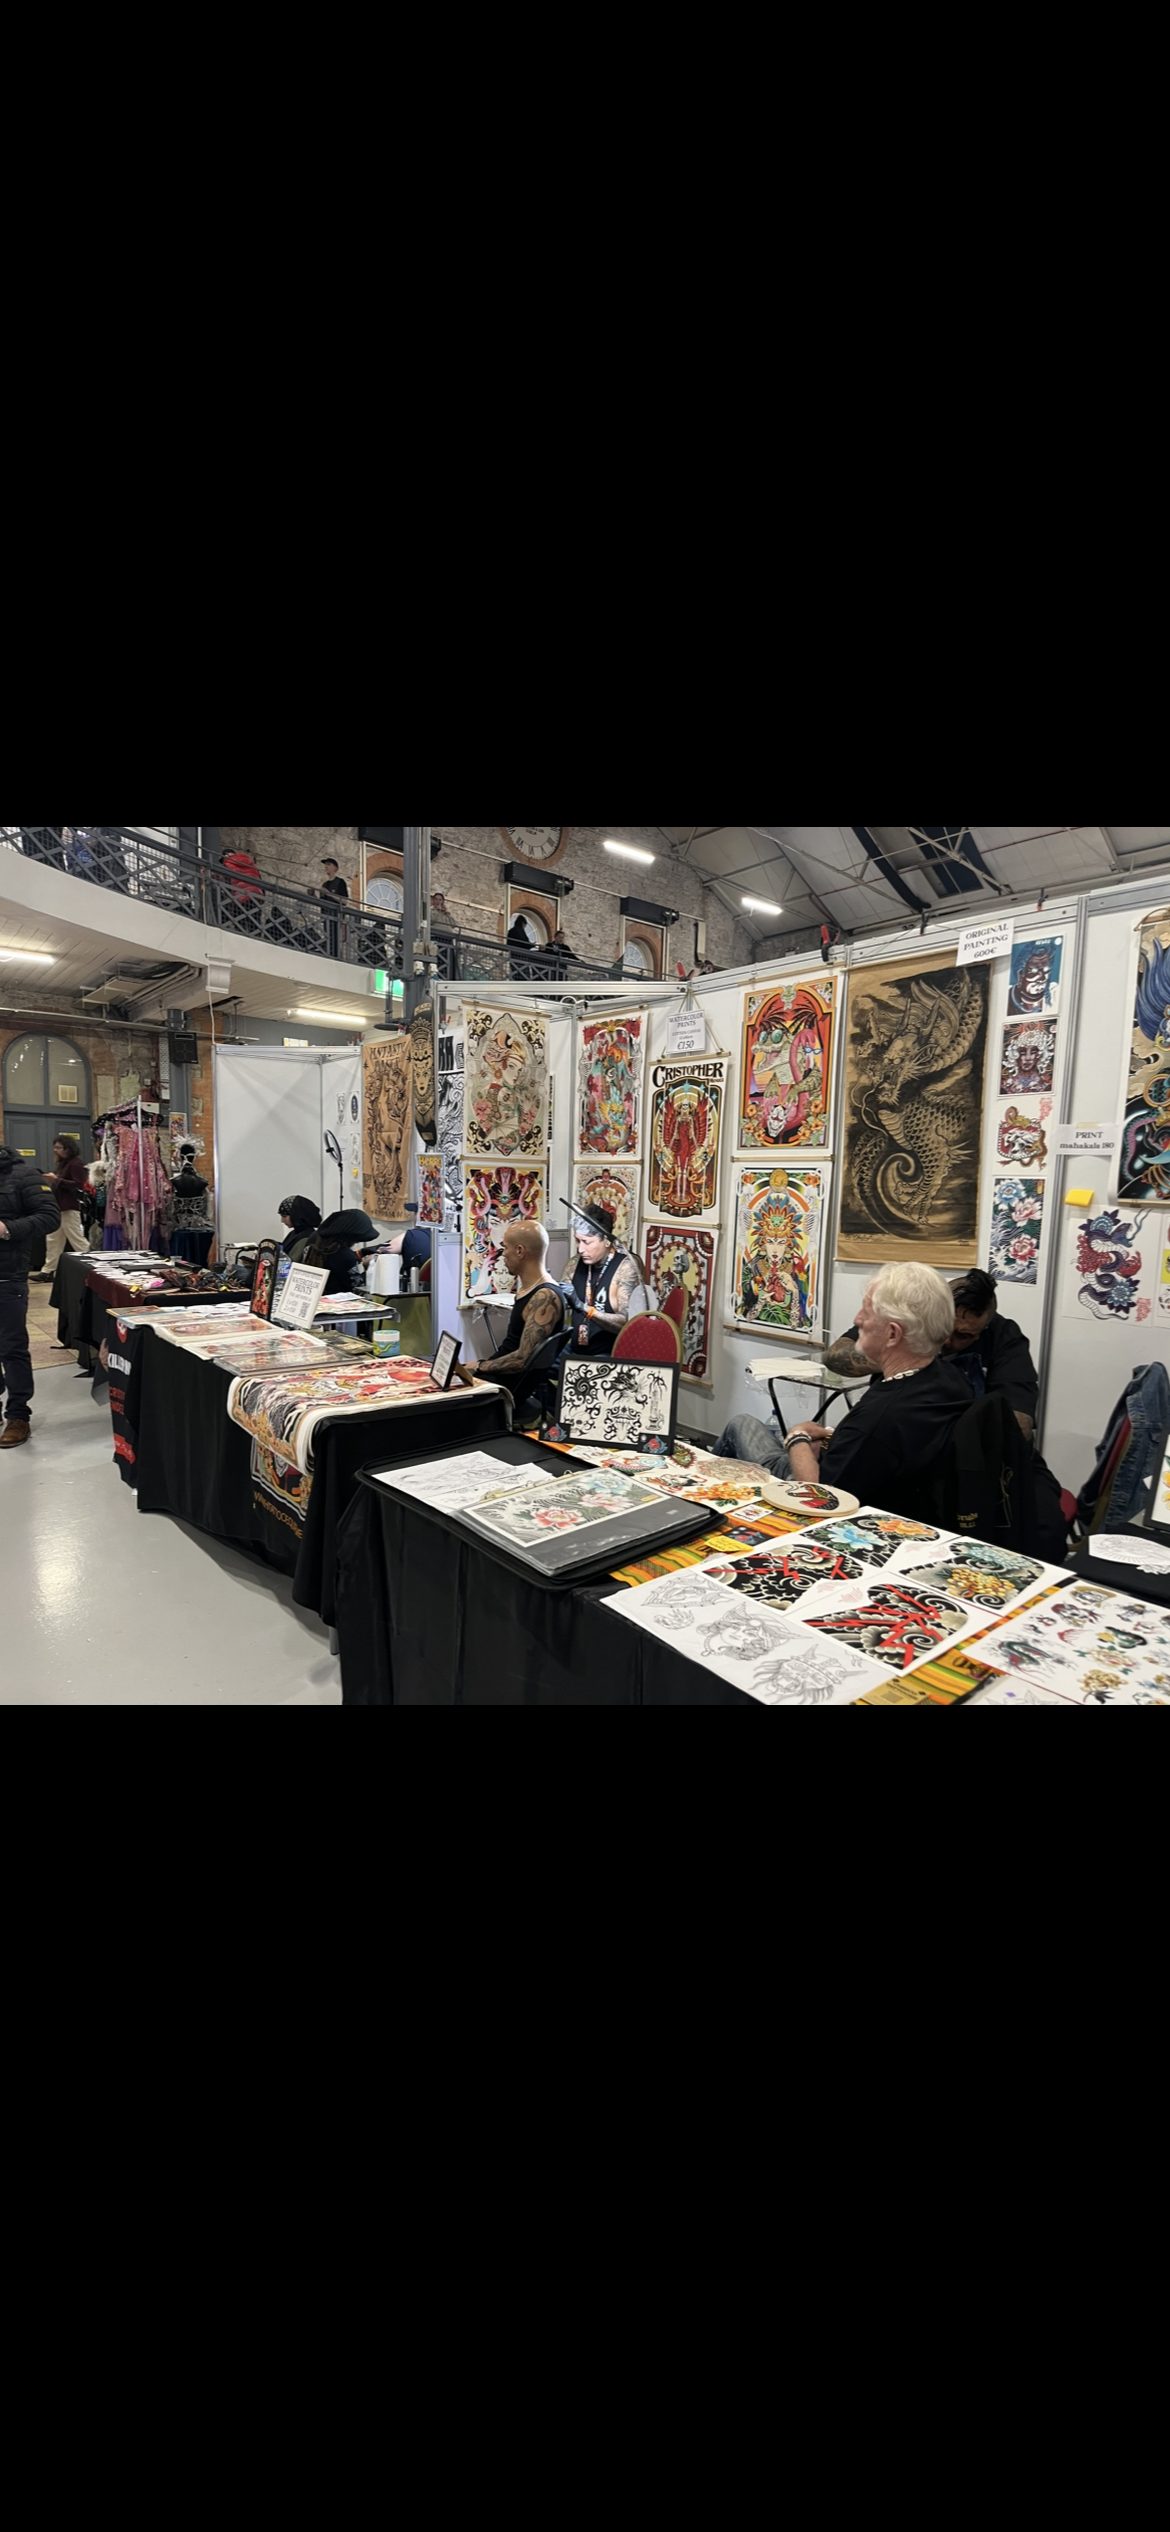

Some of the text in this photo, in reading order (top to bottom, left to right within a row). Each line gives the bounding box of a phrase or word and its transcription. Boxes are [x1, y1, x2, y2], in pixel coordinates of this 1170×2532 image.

[965, 923, 1009, 940] ORIGINAL
[963, 934, 1008, 951] PAINTING
[973, 947, 997, 958] 600€
[668, 1012, 704, 1023] WATERCOLOR
[677, 1020, 696, 1028] PRINTS
[677, 1040, 694, 1050] €150
[652, 1062, 724, 1088] CRISTOPHER
[1075, 1131, 1103, 1139] PRINT
[294, 1283, 313, 1295] PRINTS
